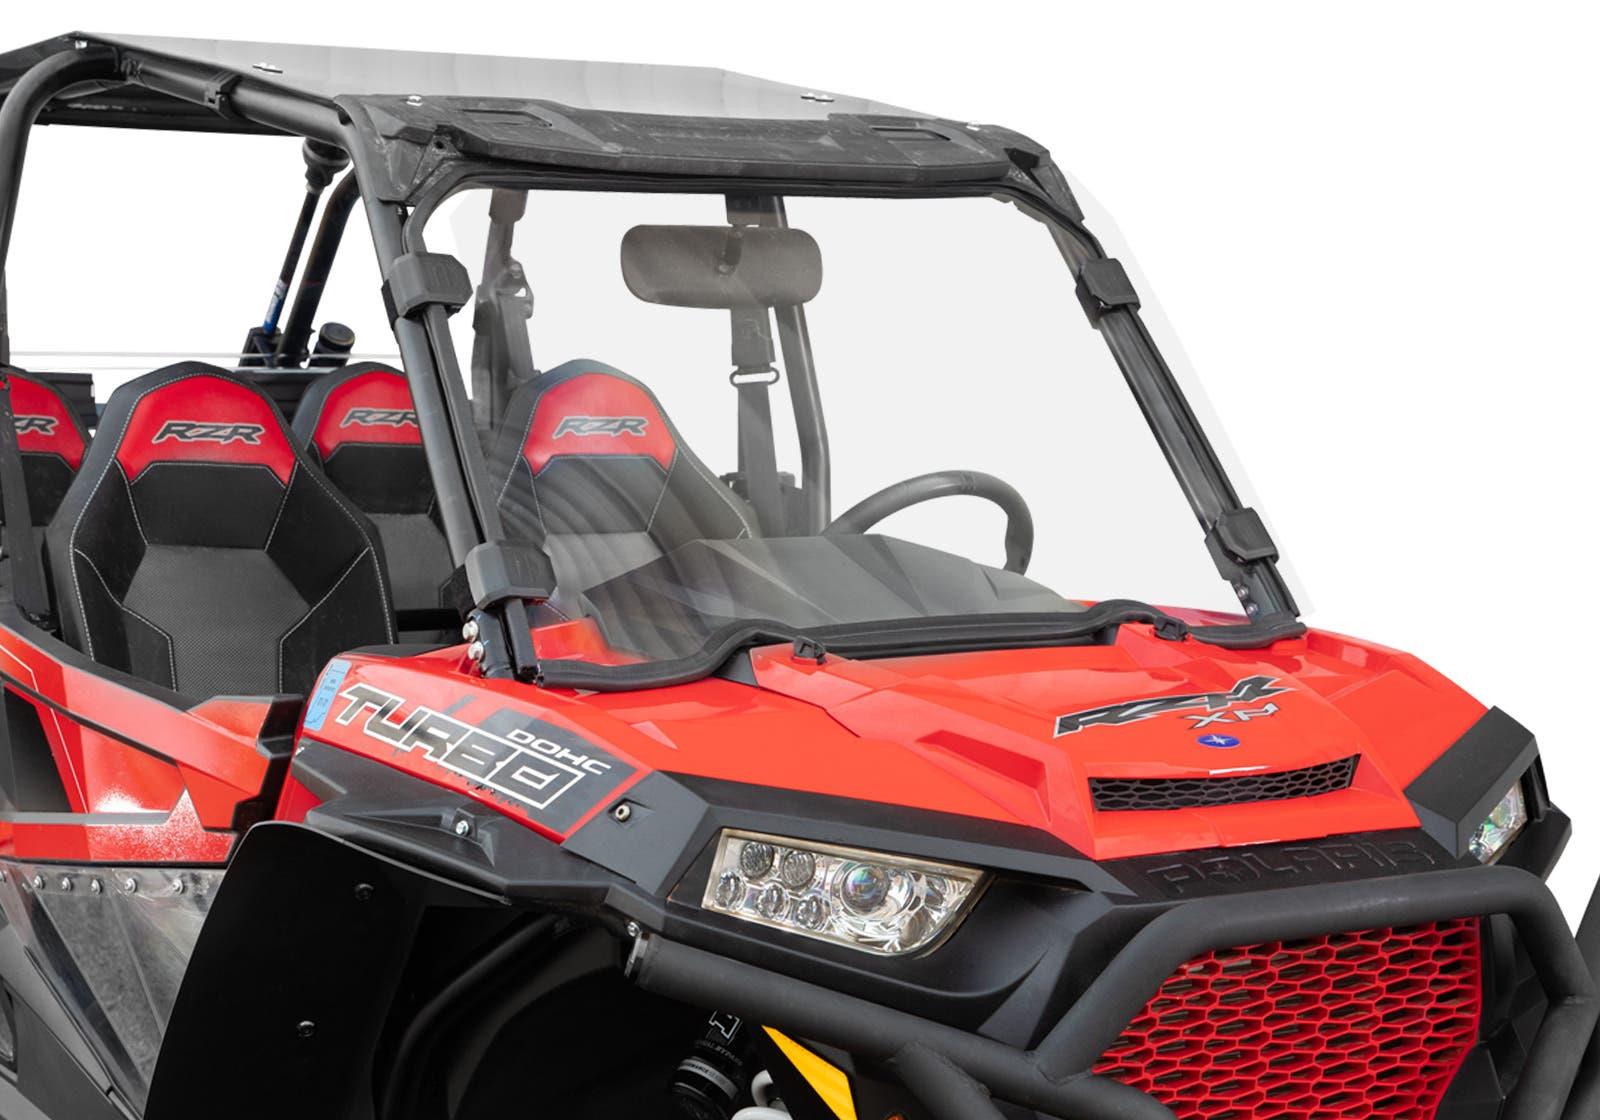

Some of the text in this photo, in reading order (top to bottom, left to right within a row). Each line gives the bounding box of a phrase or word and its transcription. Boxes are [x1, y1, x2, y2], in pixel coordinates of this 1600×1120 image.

[151, 420, 265, 444] RZR
[552, 416, 649, 440] RZR
[1053, 674, 1297, 738] RZR
[334, 682, 586, 810] TURBO
[506, 728, 612, 776] DOHC
[1146, 841, 1436, 894] POLARIS
